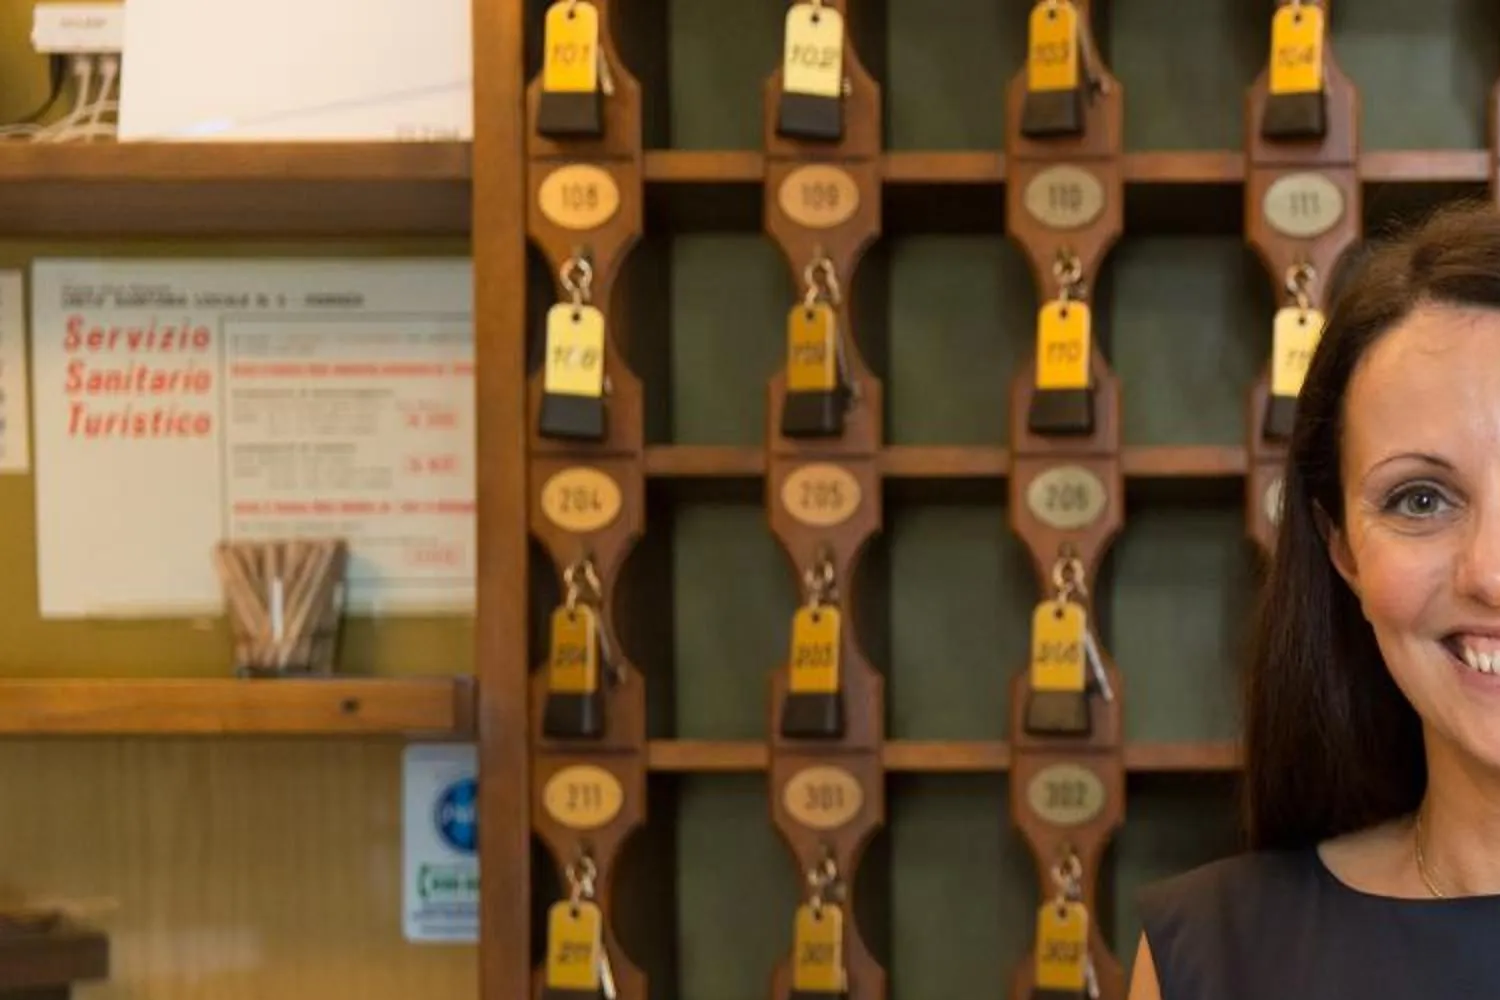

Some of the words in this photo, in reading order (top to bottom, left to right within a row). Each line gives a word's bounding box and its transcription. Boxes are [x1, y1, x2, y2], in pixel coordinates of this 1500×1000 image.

[788, 43, 839, 69] 102
[560, 183, 600, 210] 108
[62, 314, 212, 354] Servizio
[63, 358, 212, 396] Sanitario
[66, 402, 212, 440] Turistico
[558, 486, 604, 514] 204
[798, 481, 844, 511] 205
[804, 782, 847, 811] 301
